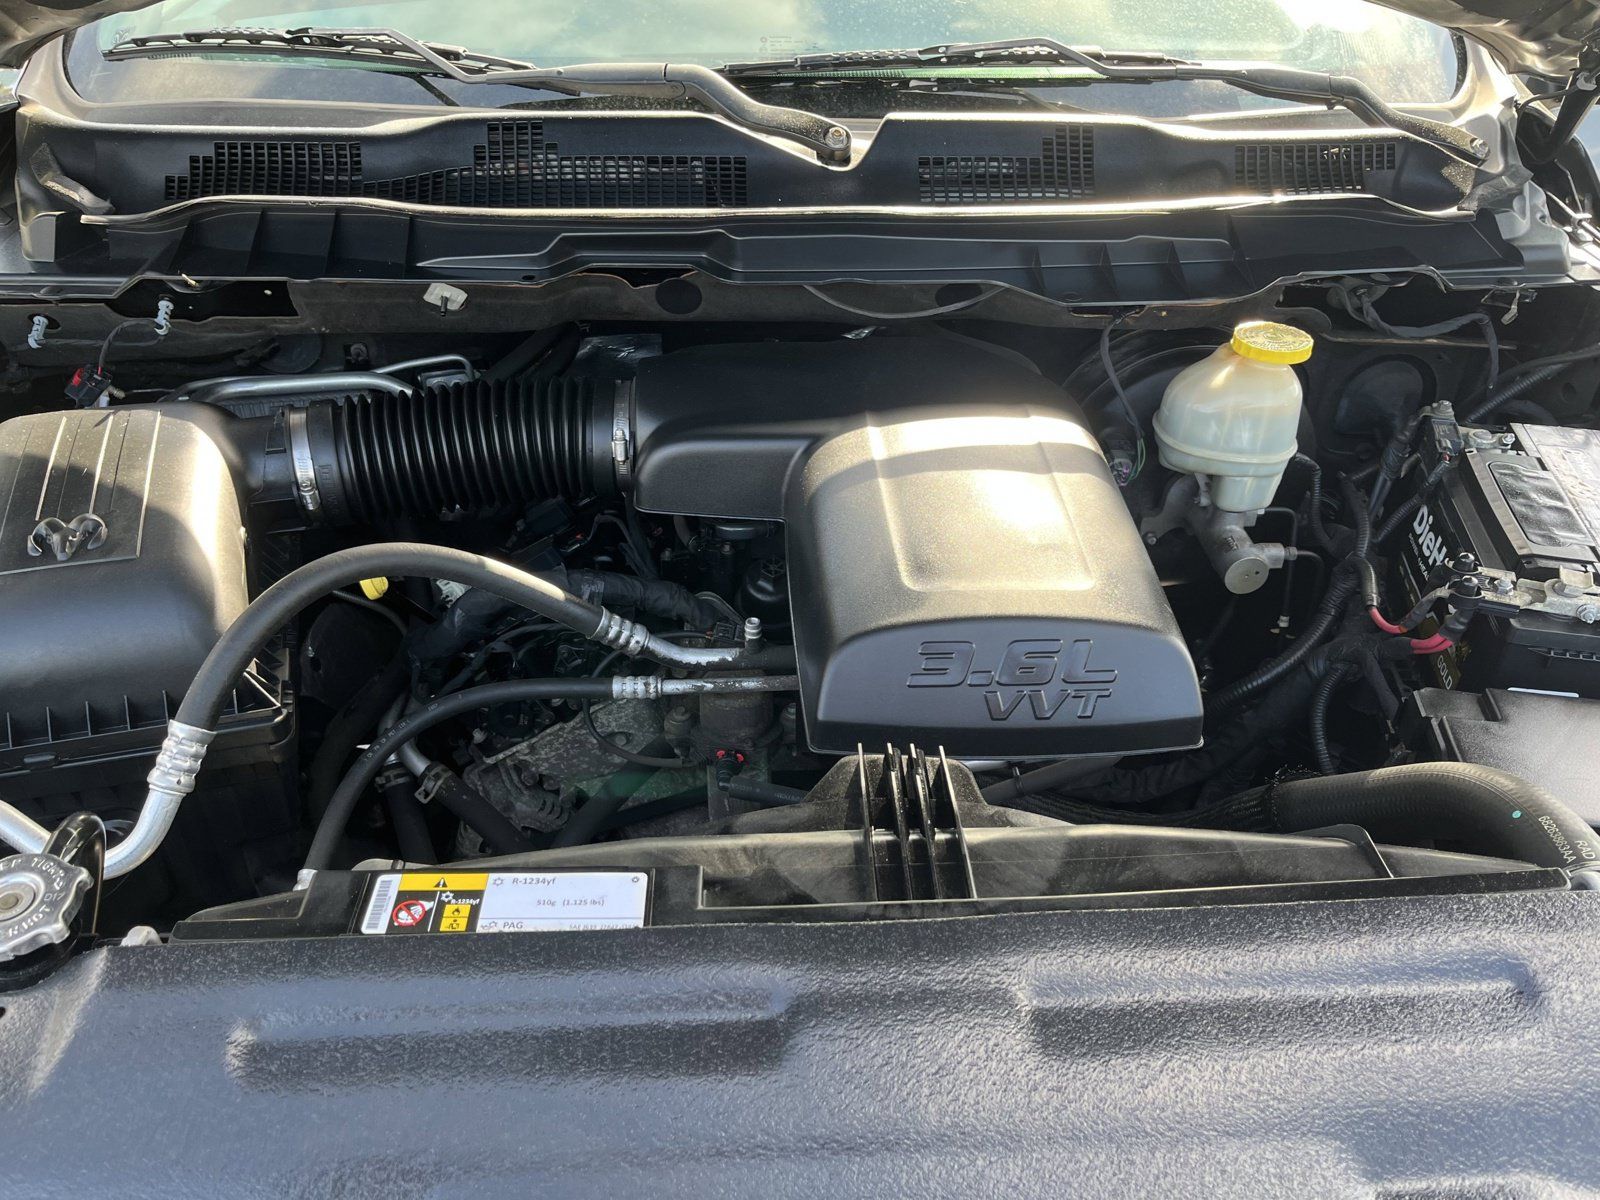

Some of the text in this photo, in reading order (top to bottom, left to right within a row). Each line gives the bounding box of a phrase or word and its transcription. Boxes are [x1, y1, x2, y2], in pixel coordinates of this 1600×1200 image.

[1413, 505, 1448, 567] DieH
[906, 638, 1119, 689] 3.6L
[1437, 654, 1453, 690] GOLD
[983, 687, 1113, 722] VVT
[1574, 840, 1596, 860] RAD
[512, 877, 557, 887] R-1234yf
[536, 899, 557, 907] 510g
[502, 921, 524, 930] PAG
